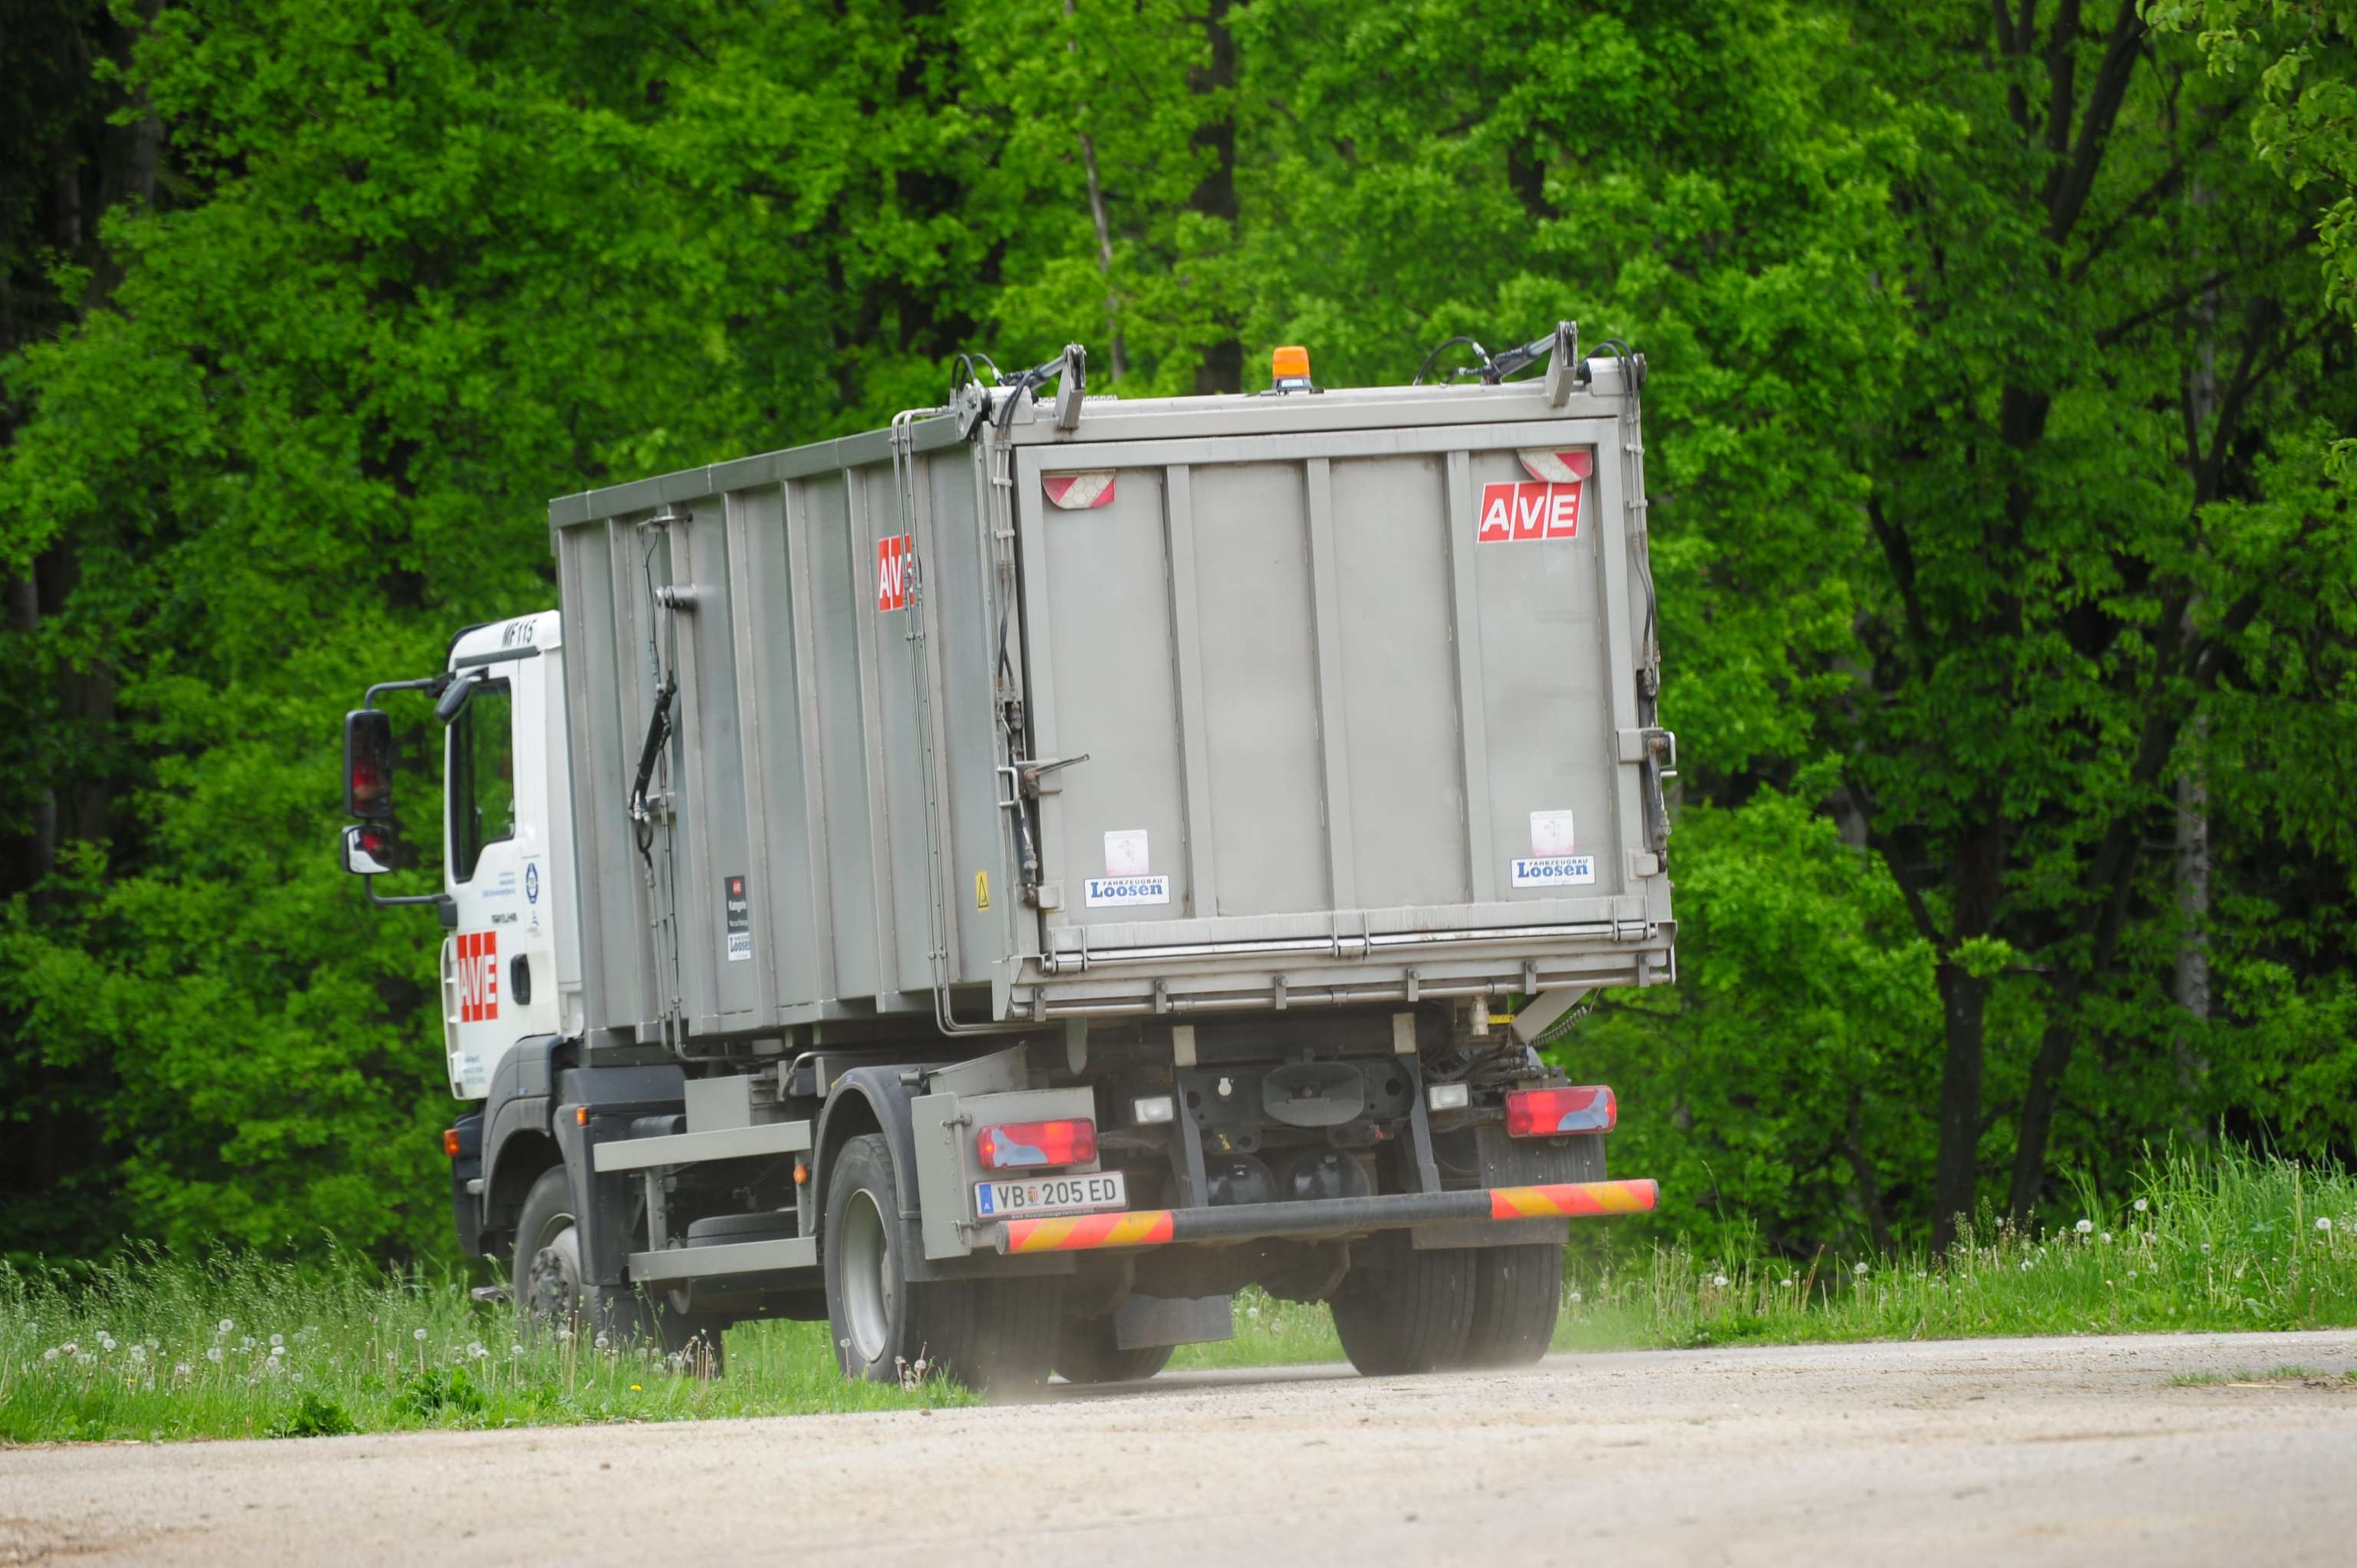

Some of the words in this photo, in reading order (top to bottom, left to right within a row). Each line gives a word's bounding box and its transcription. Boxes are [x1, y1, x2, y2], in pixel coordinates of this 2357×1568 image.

[1480, 494, 1577, 532] AVE
[1517, 861, 1588, 878] Loosen
[1529, 858, 1588, 867] FAHRZEUGBAU
[1090, 882, 1163, 898] Loosen
[730, 937, 749, 953] Loose
[460, 954, 496, 1006] AVE
[997, 1186, 1024, 1209] VB
[1042, 1181, 1083, 1205] 205
[1089, 1179, 1116, 1202] ED
